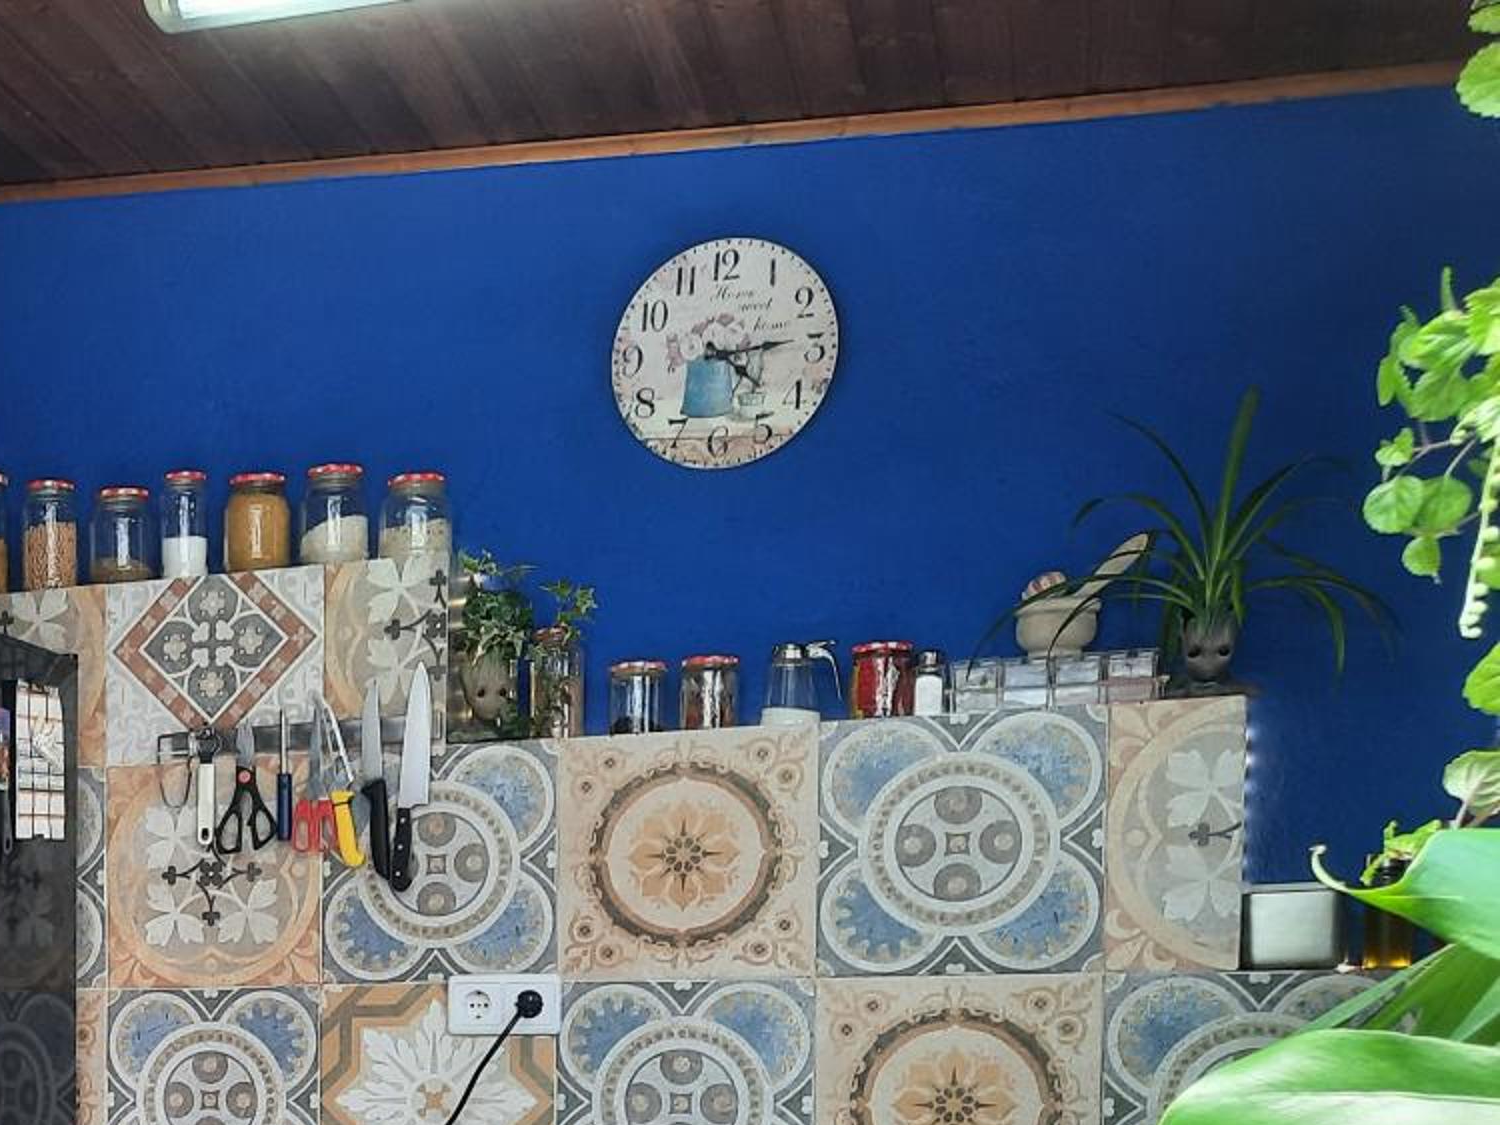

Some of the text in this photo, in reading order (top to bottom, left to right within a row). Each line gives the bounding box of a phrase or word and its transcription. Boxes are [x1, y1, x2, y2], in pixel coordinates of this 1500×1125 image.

[675, 266, 695, 297] 11
[713, 249, 740, 282] 12
[768, 258, 777, 286] 1
[641, 300, 669, 333] 10
[794, 287, 815, 319] 2
[622, 345, 644, 377] 9
[804, 332, 825, 364] 3
[635, 388, 656, 418] 8
[782, 379, 804, 411] 4
[668, 418, 689, 449] 7
[707, 426, 730, 458] 6
[753, 412, 775, 445] 5
